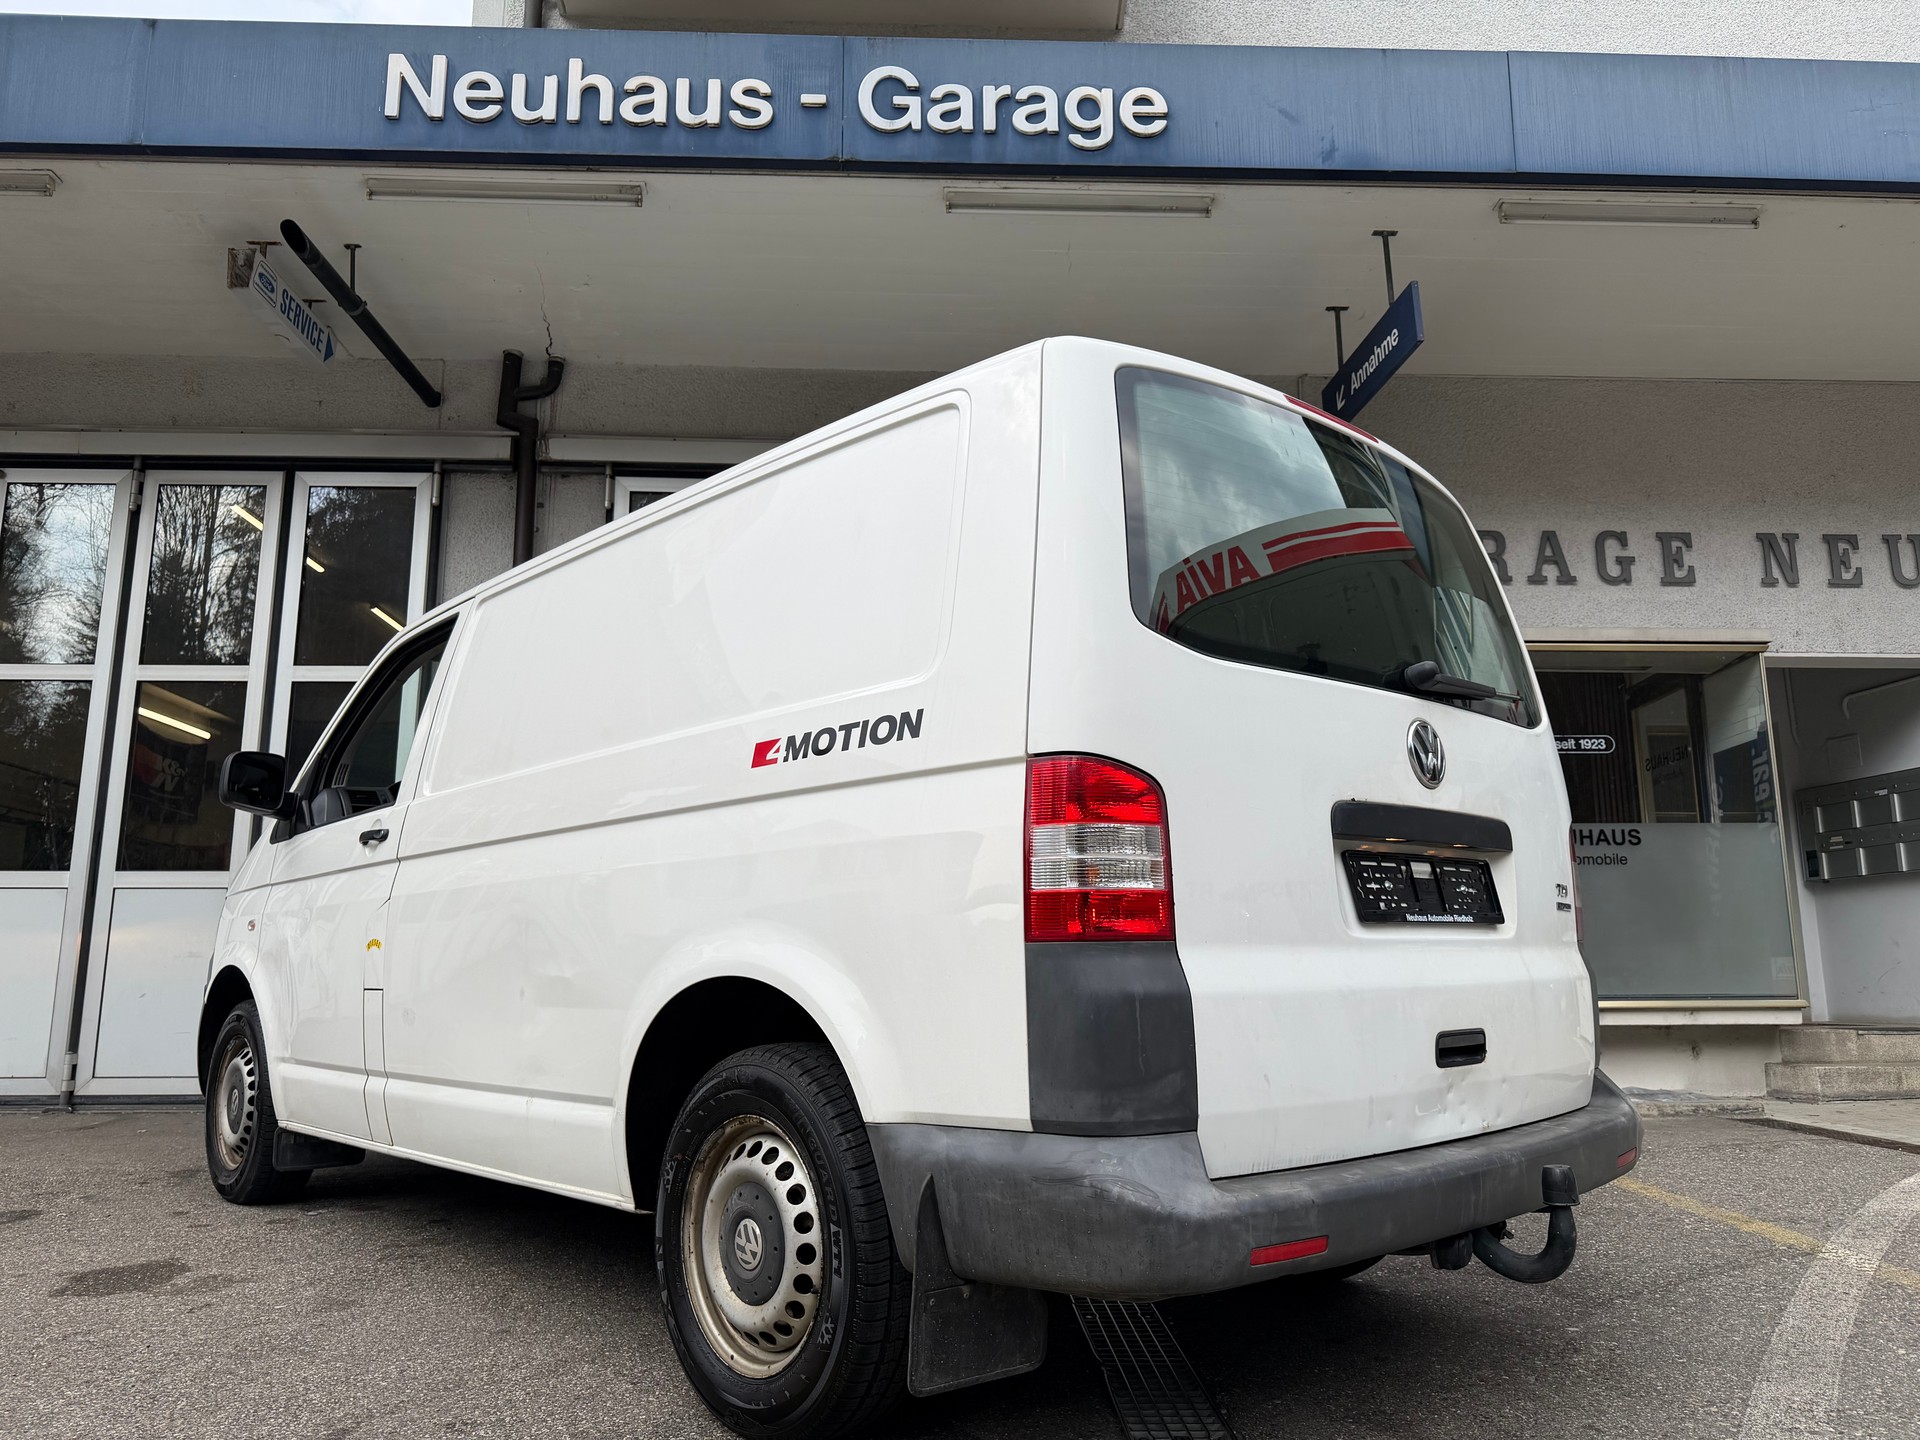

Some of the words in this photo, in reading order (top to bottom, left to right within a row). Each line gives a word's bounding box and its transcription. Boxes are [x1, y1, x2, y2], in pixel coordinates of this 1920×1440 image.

[384, 53, 774, 129] Neuhaus
[800, 92, 828, 108] -
[857, 65, 1169, 151] Garage
[280, 288, 325, 354] SERVICE
[1350, 328, 1399, 395] Annahme
[751, 708, 925, 769] 4MOTION
[1555, 738, 1577, 750] seit
[1578, 738, 1607, 750] 1923
[1574, 828, 1642, 846] HAUS
